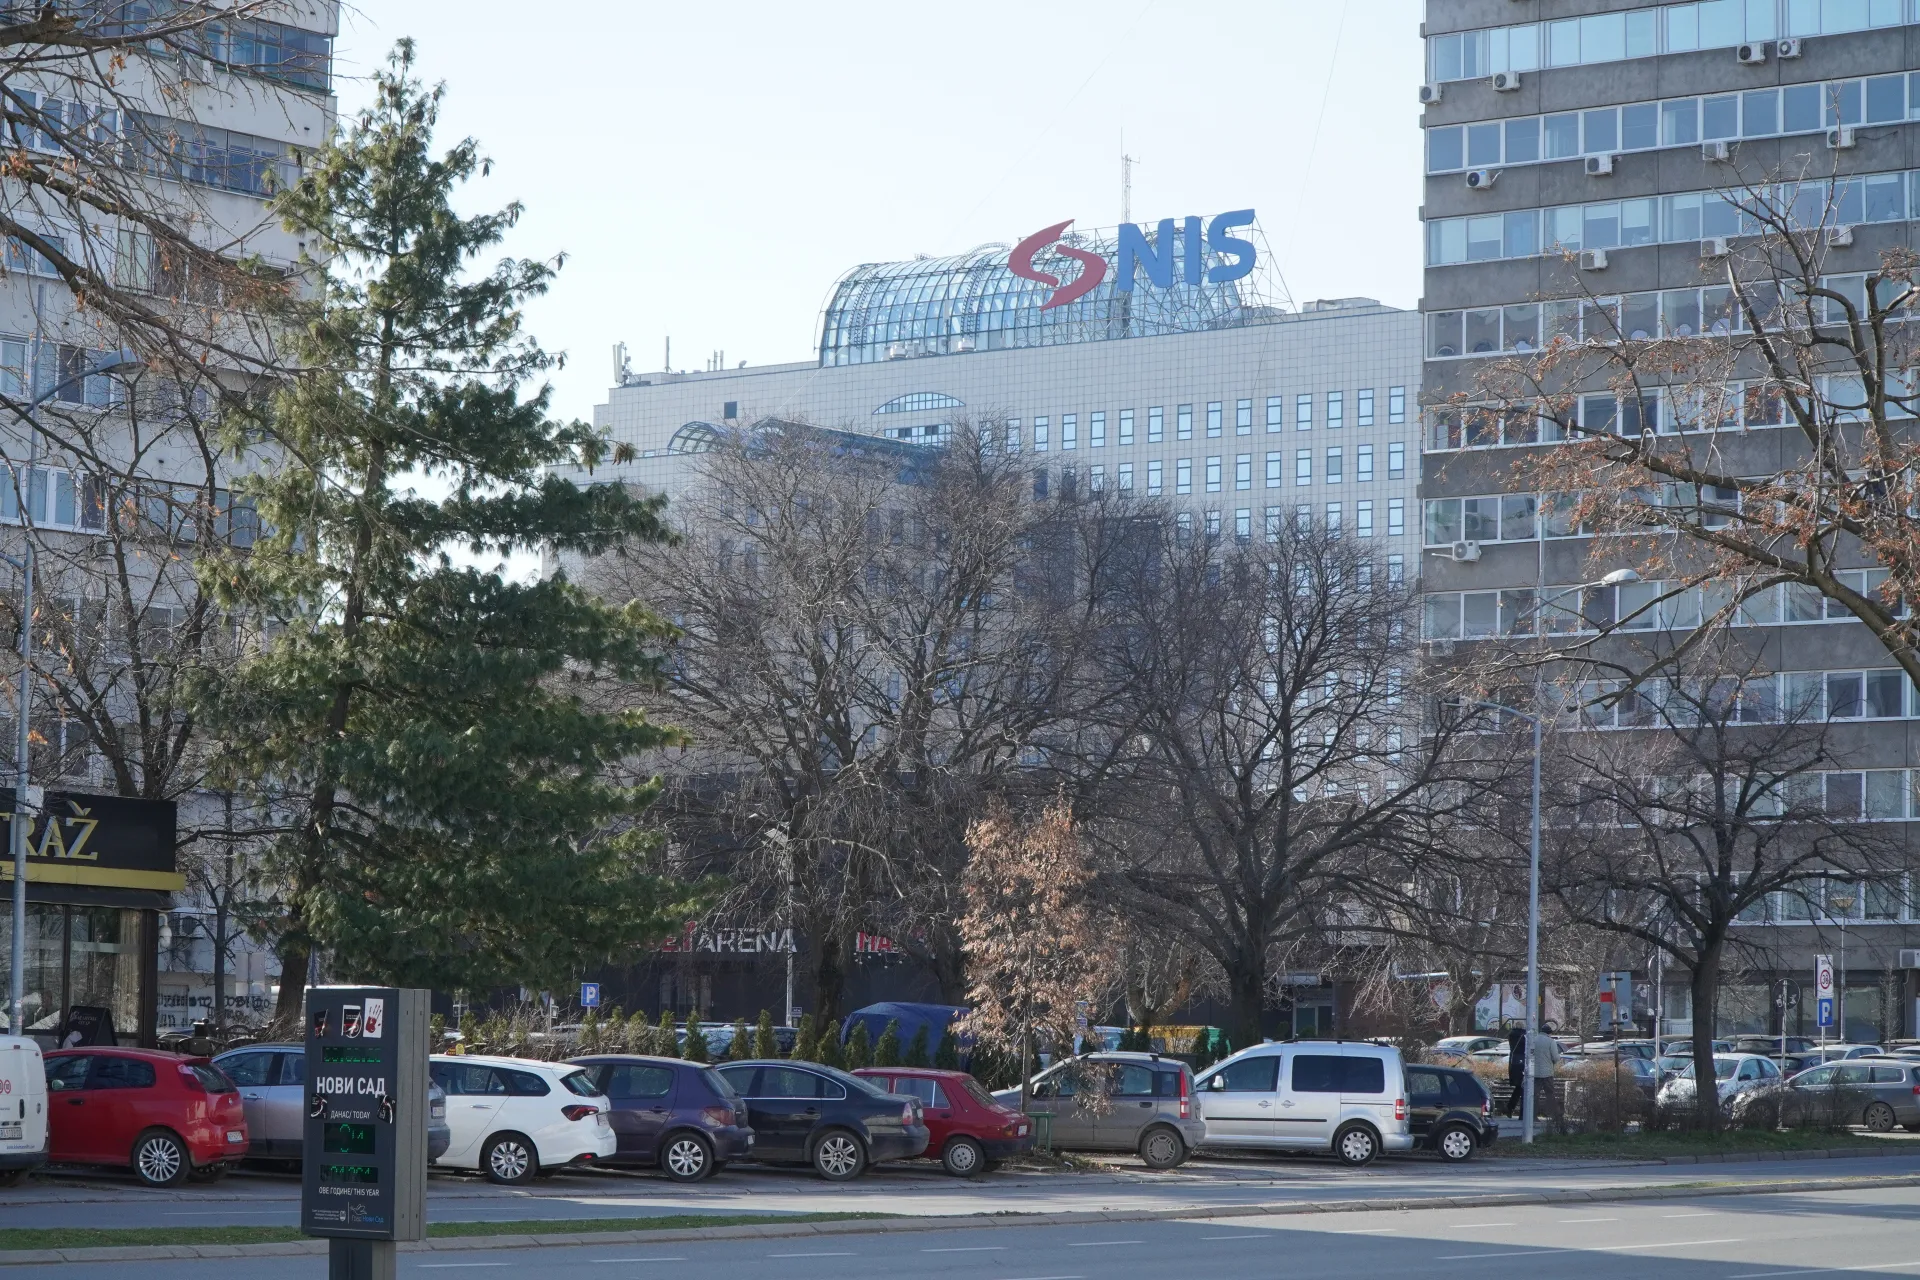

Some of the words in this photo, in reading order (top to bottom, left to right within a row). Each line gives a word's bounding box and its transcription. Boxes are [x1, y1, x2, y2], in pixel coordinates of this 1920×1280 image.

[1117, 208, 1257, 292] NIS
[695, 927, 797, 953] ARENA
[586, 986, 597, 1004] P
[1822, 1002, 1831, 1023] P
[316, 1076, 354, 1094] НОВИ
[357, 1077, 386, 1099] САД
[353, 1110, 371, 1119] TODAY
[318, 1186, 329, 1194] ОВЕ
[354, 1188, 365, 1196] THIS
[366, 1188, 380, 1197] YEAR
